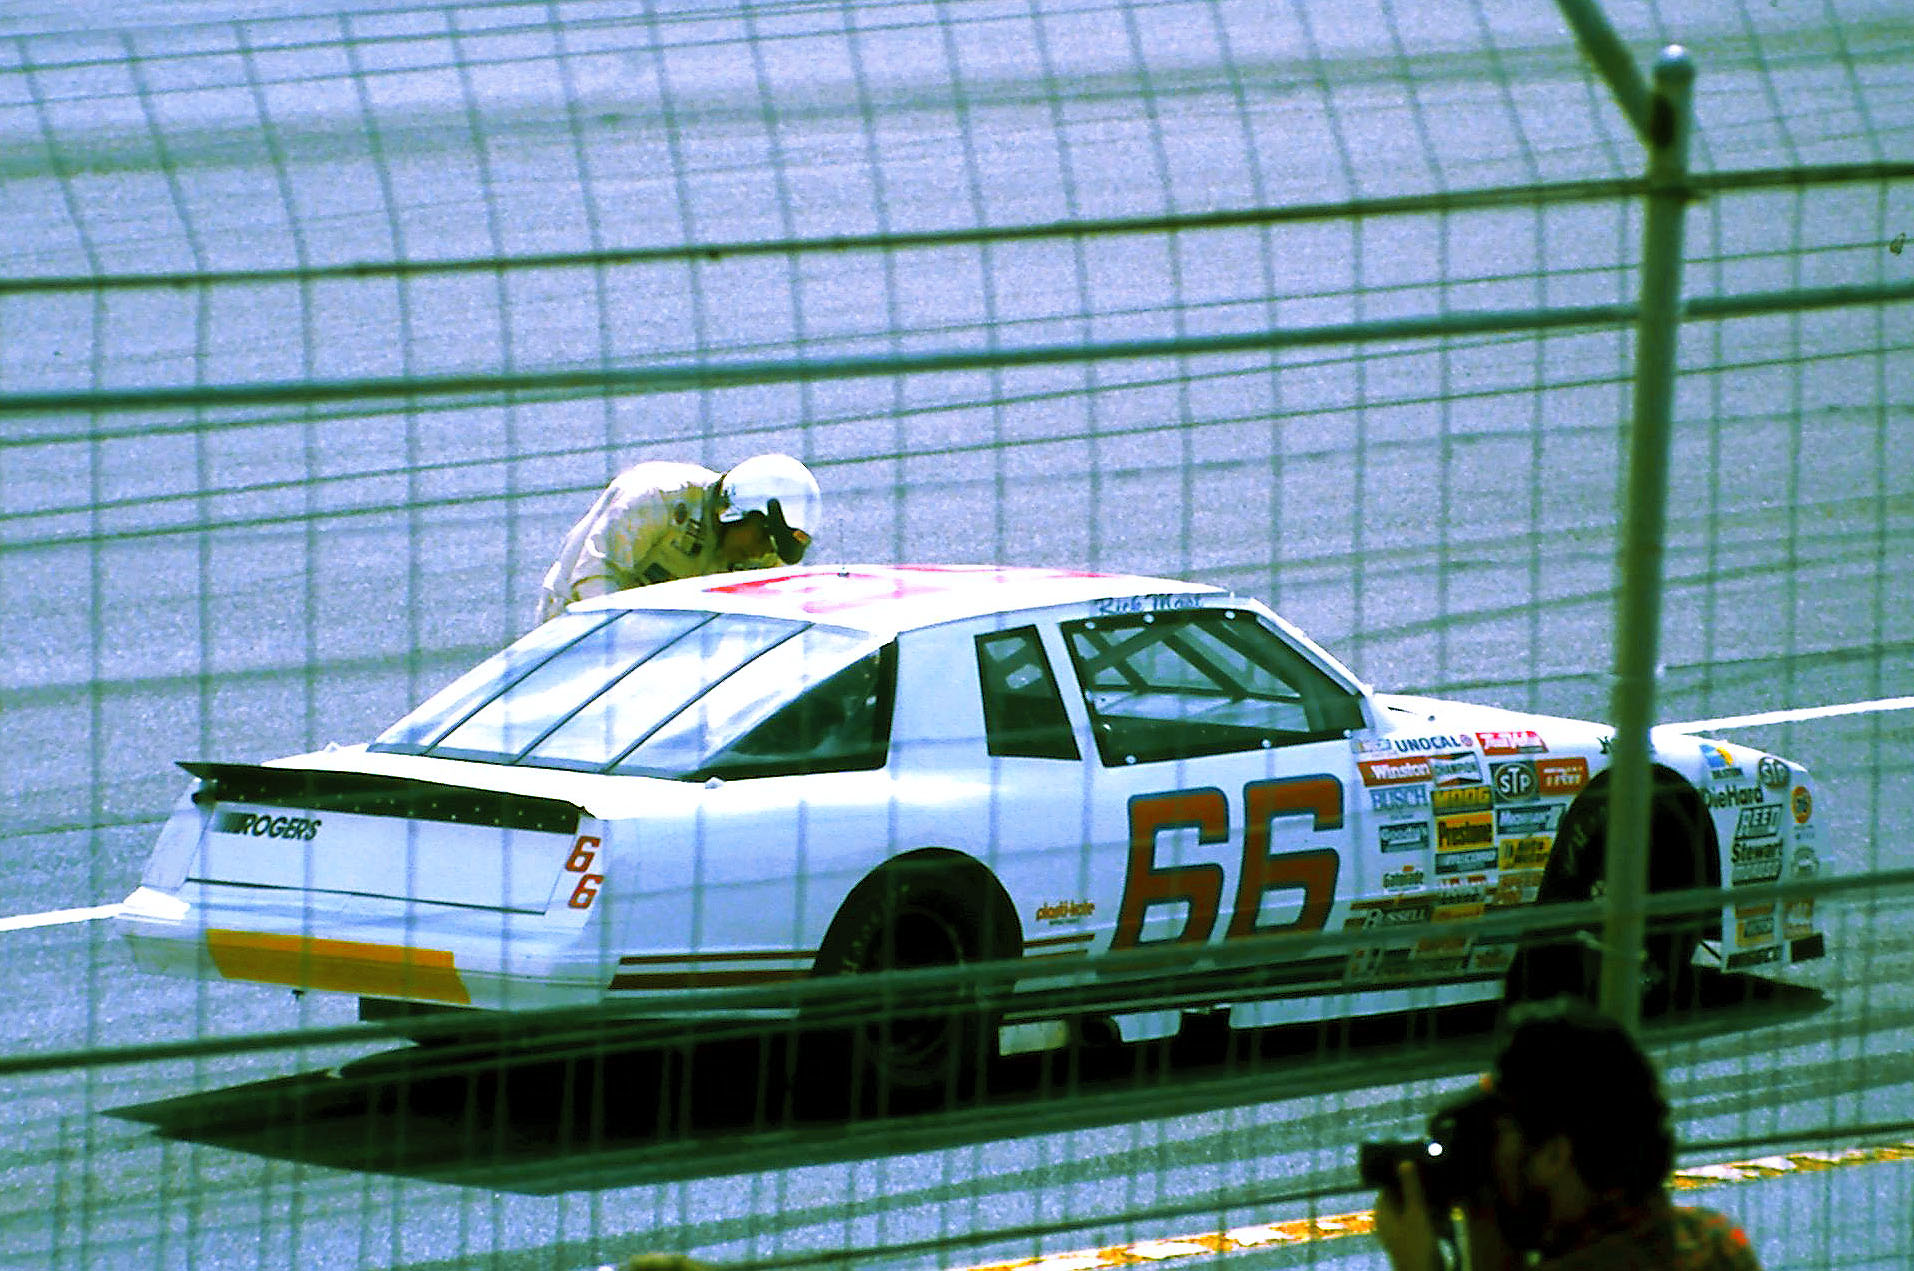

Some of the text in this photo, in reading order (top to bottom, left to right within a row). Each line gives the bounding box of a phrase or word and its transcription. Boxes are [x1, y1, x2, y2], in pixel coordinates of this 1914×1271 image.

[1395, 735, 1461, 752] UNOCAL
[1369, 762, 1431, 780] Winston
[1499, 766, 1532, 794] STP
[241, 812, 323, 841] ROGERS
[563, 835, 602, 874] 6
[1108, 773, 1344, 953] 66
[567, 873, 604, 910] 6
